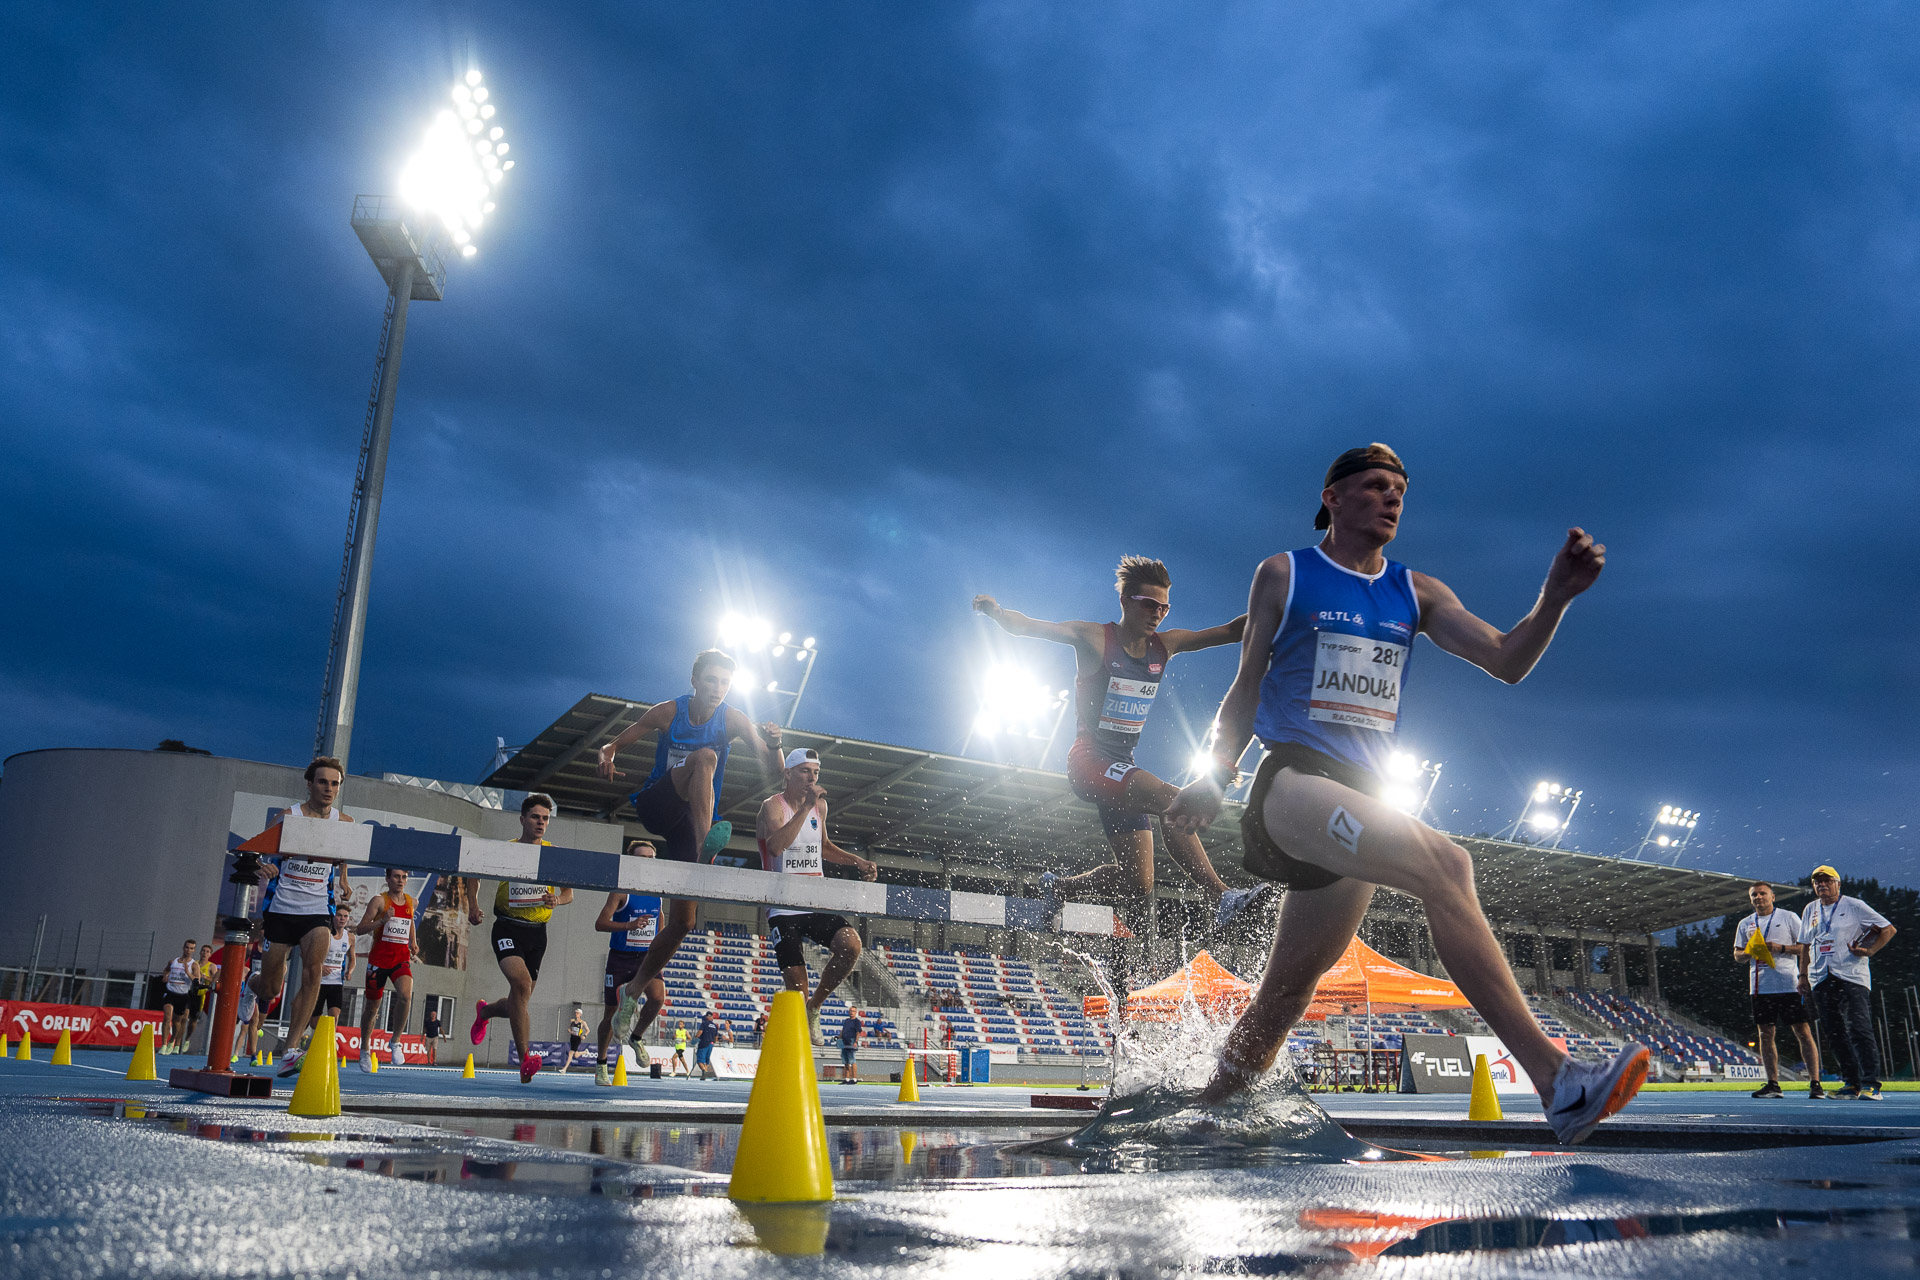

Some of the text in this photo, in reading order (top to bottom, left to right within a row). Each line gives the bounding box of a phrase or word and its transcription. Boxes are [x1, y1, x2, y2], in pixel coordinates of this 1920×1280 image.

[1319, 611, 1350, 621] RLTL
[1339, 645, 1362, 654] SPORT
[1372, 647, 1400, 667] 281
[1140, 685, 1156, 696] 468
[1317, 670, 1397, 701] JANDUŁA
[1332, 713, 1365, 724] RADOM
[1109, 762, 1129, 777] 19
[1332, 811, 1354, 846] 17
[806, 845, 818, 853] 381
[288, 862, 325, 876] CHRABĄSZCZ
[785, 858, 818, 869] PEMPUŚ
[500, 940, 513, 949] 16
[42, 1014, 92, 1032] ORLEN
[1411, 1051, 1471, 1077] 4F FUEL
[1730, 1066, 1760, 1077] RADOM
